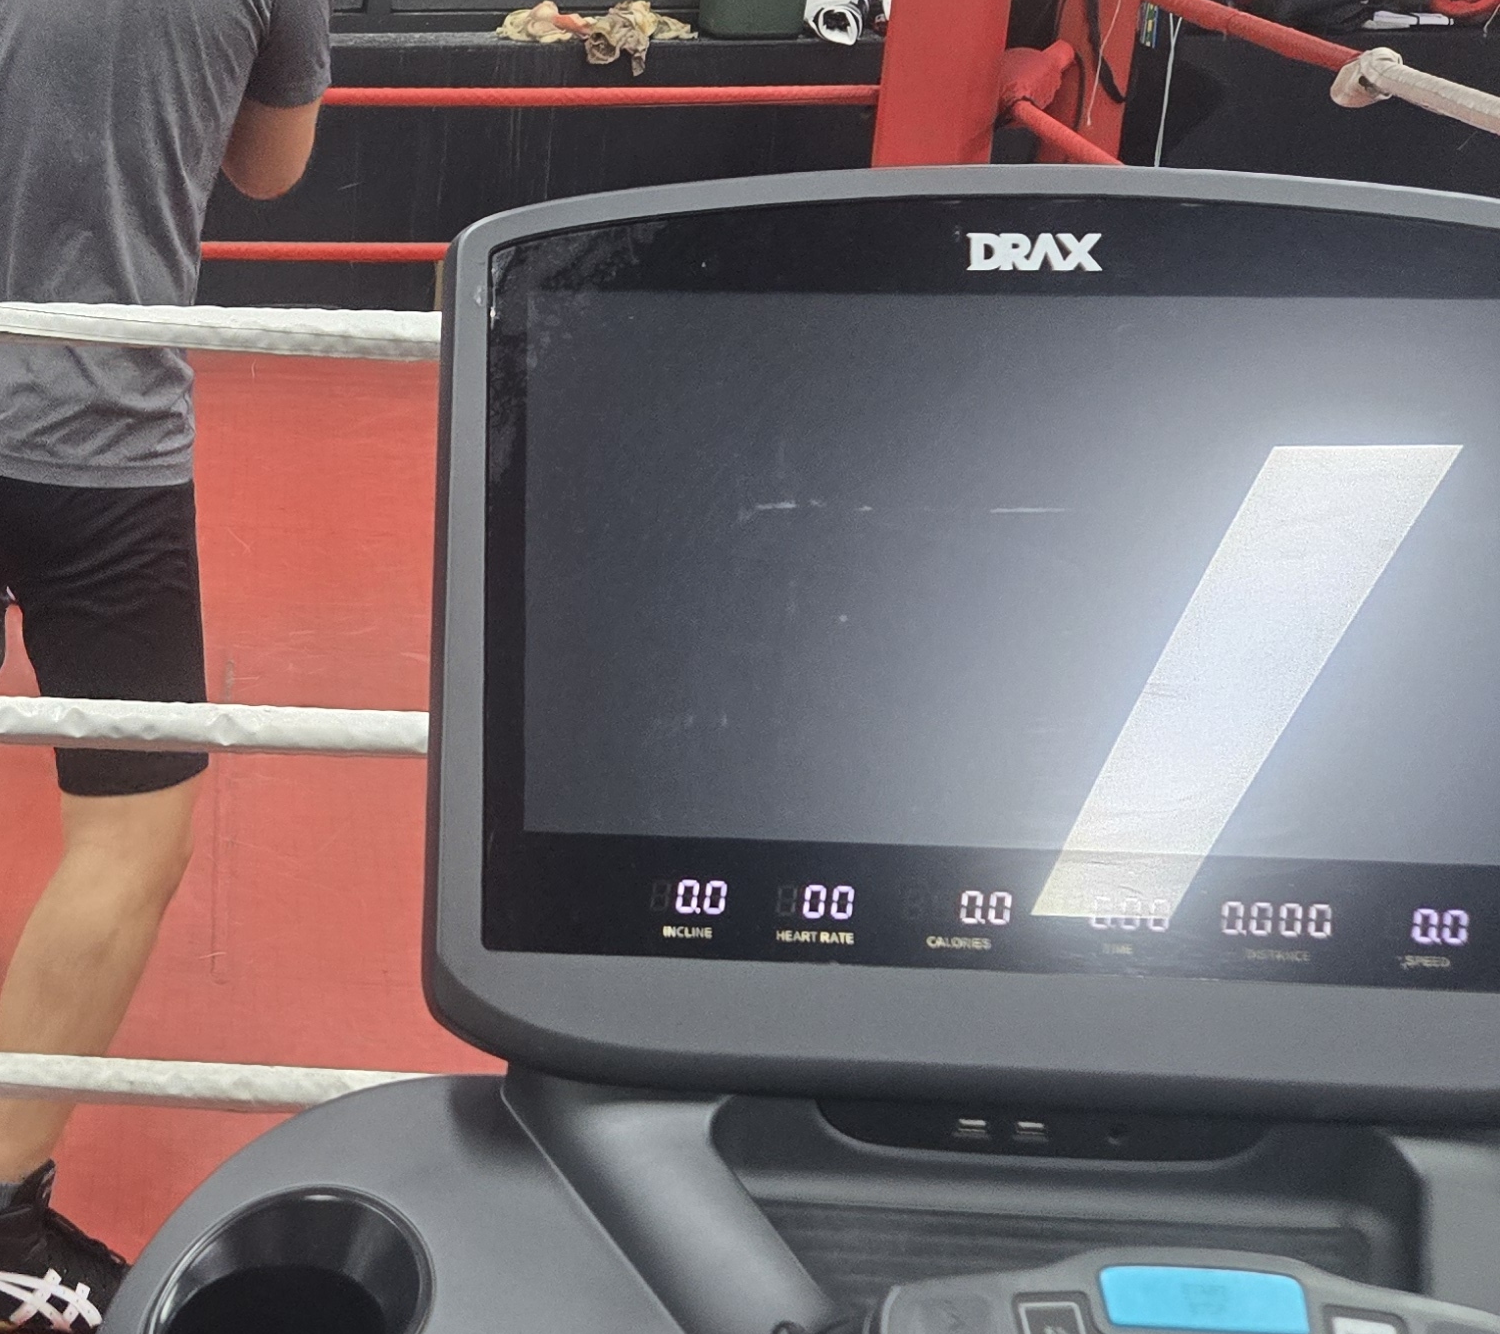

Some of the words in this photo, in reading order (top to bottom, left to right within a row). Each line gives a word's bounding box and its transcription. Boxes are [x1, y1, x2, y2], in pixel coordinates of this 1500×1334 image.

[966, 232, 1103, 273] DRAX
[662, 925, 713, 940] INCLINE
[776, 929, 817, 944] HEART
[819, 930, 855, 945] RATE
